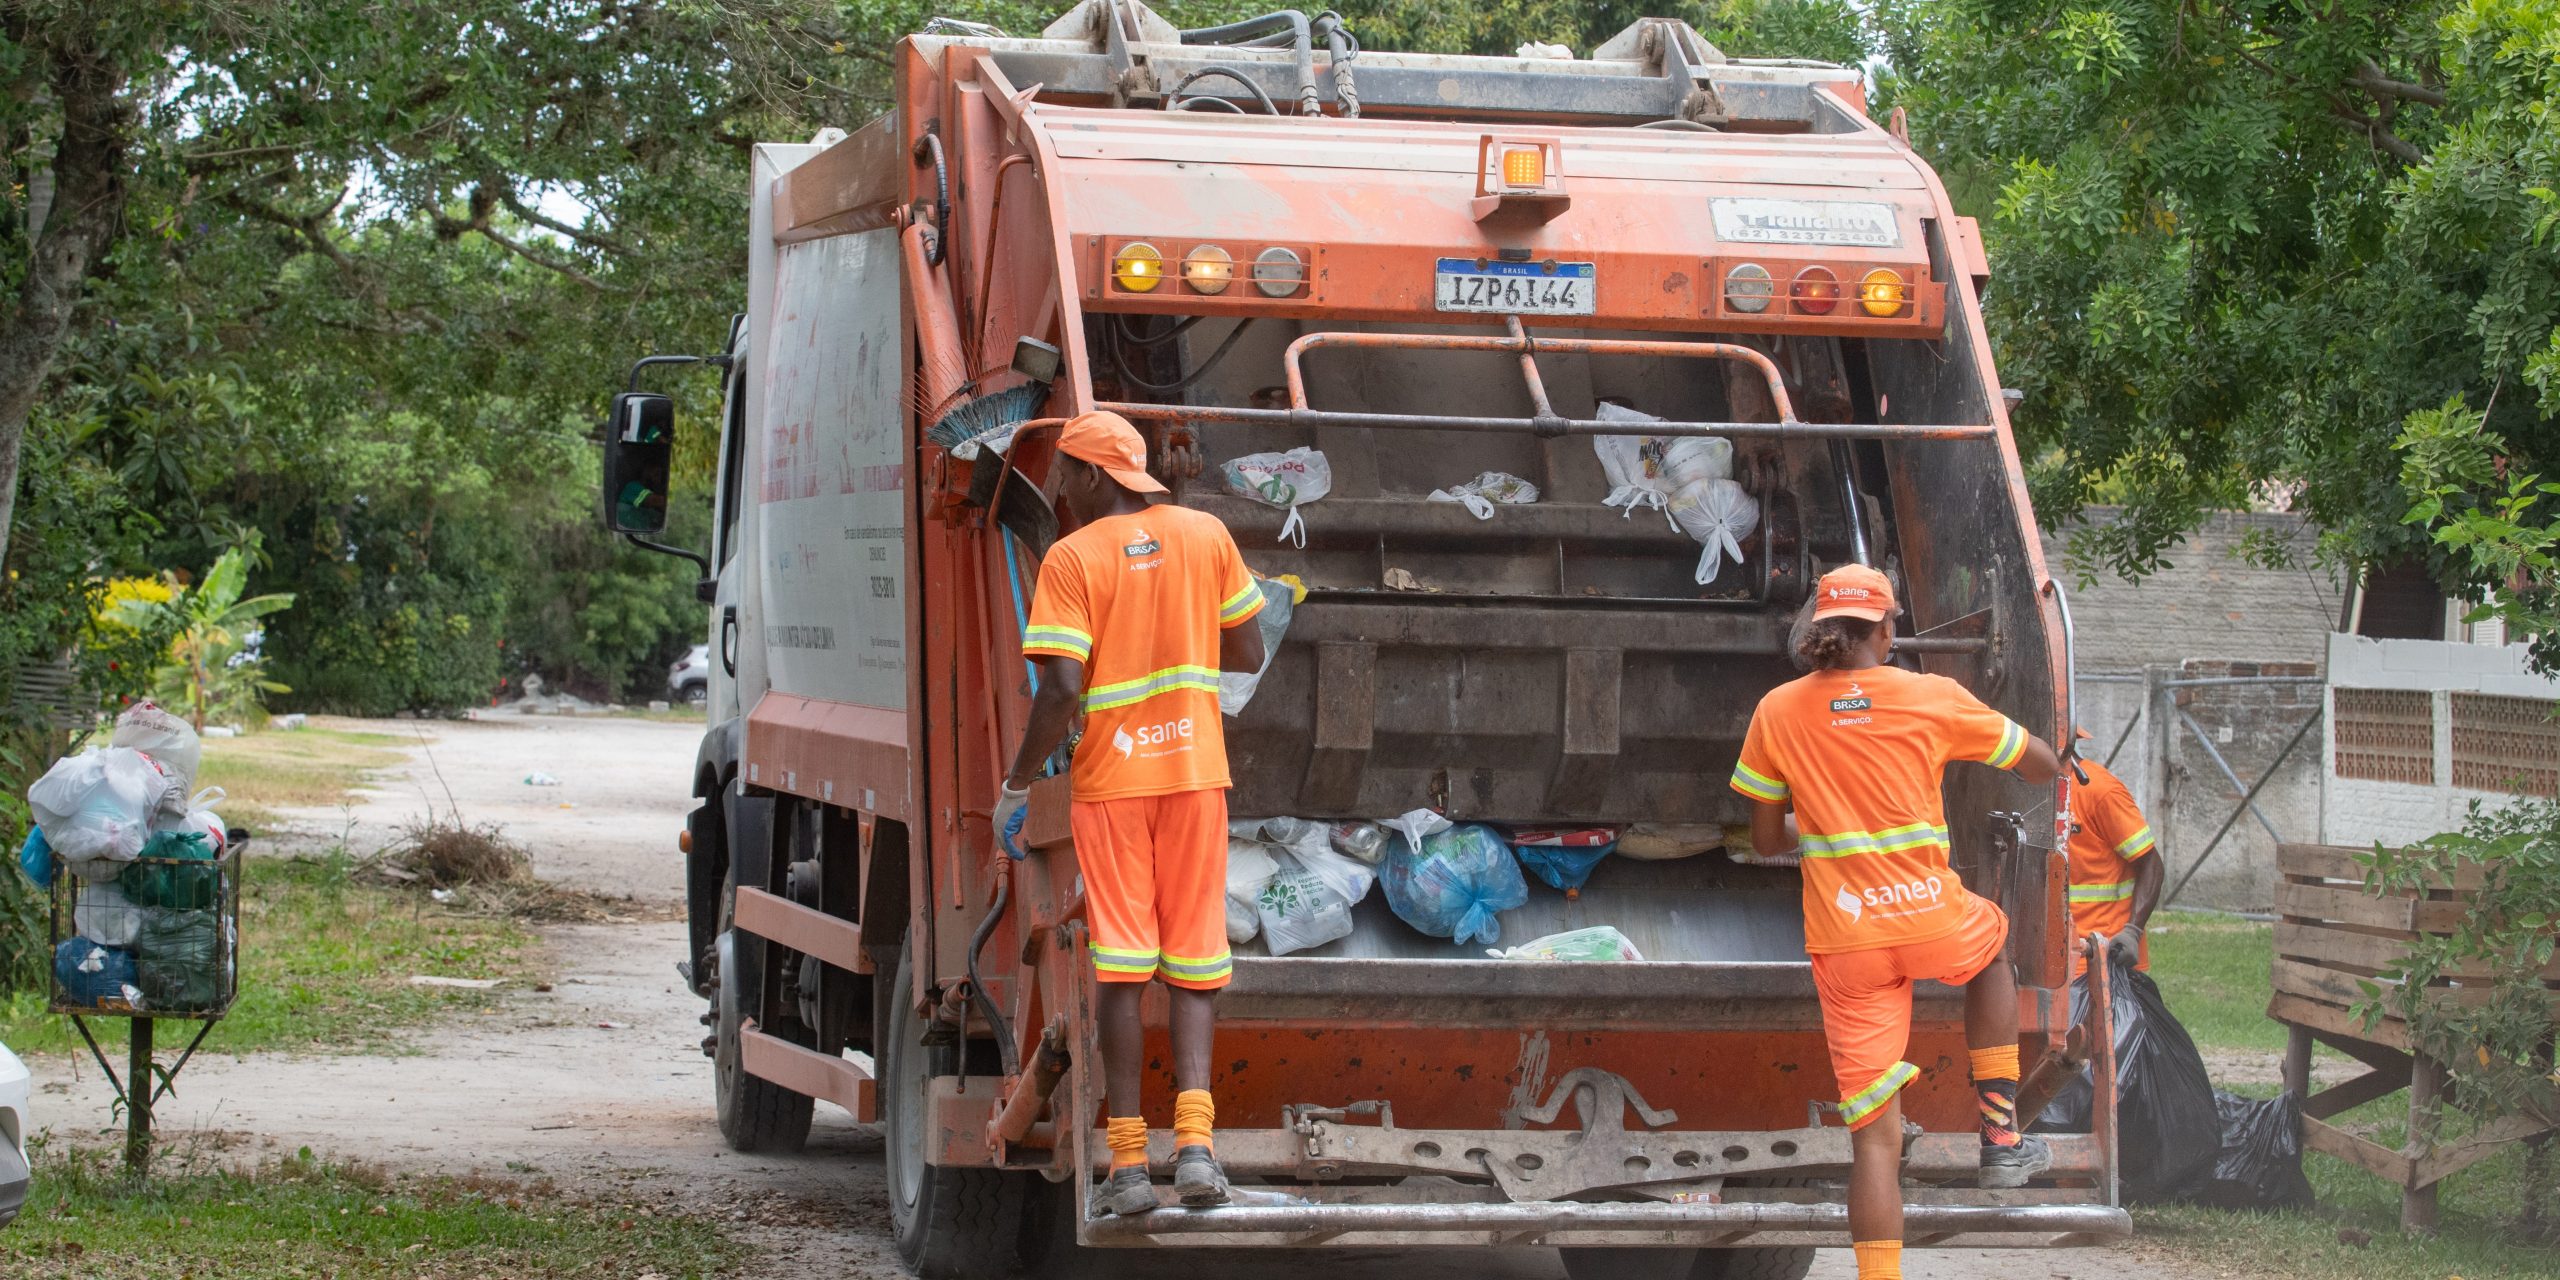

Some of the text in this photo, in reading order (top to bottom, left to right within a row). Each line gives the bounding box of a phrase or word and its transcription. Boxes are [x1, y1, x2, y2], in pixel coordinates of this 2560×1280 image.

[1731, 228, 1888, 243] (62) 3237-2400
[1502, 267, 1528, 275] BRASIL
[1838, 587, 1870, 599] sanep
[141, 719, 152, 729] do
[1136, 717, 1194, 745] sane
[1863, 876, 1942, 907] sanep
